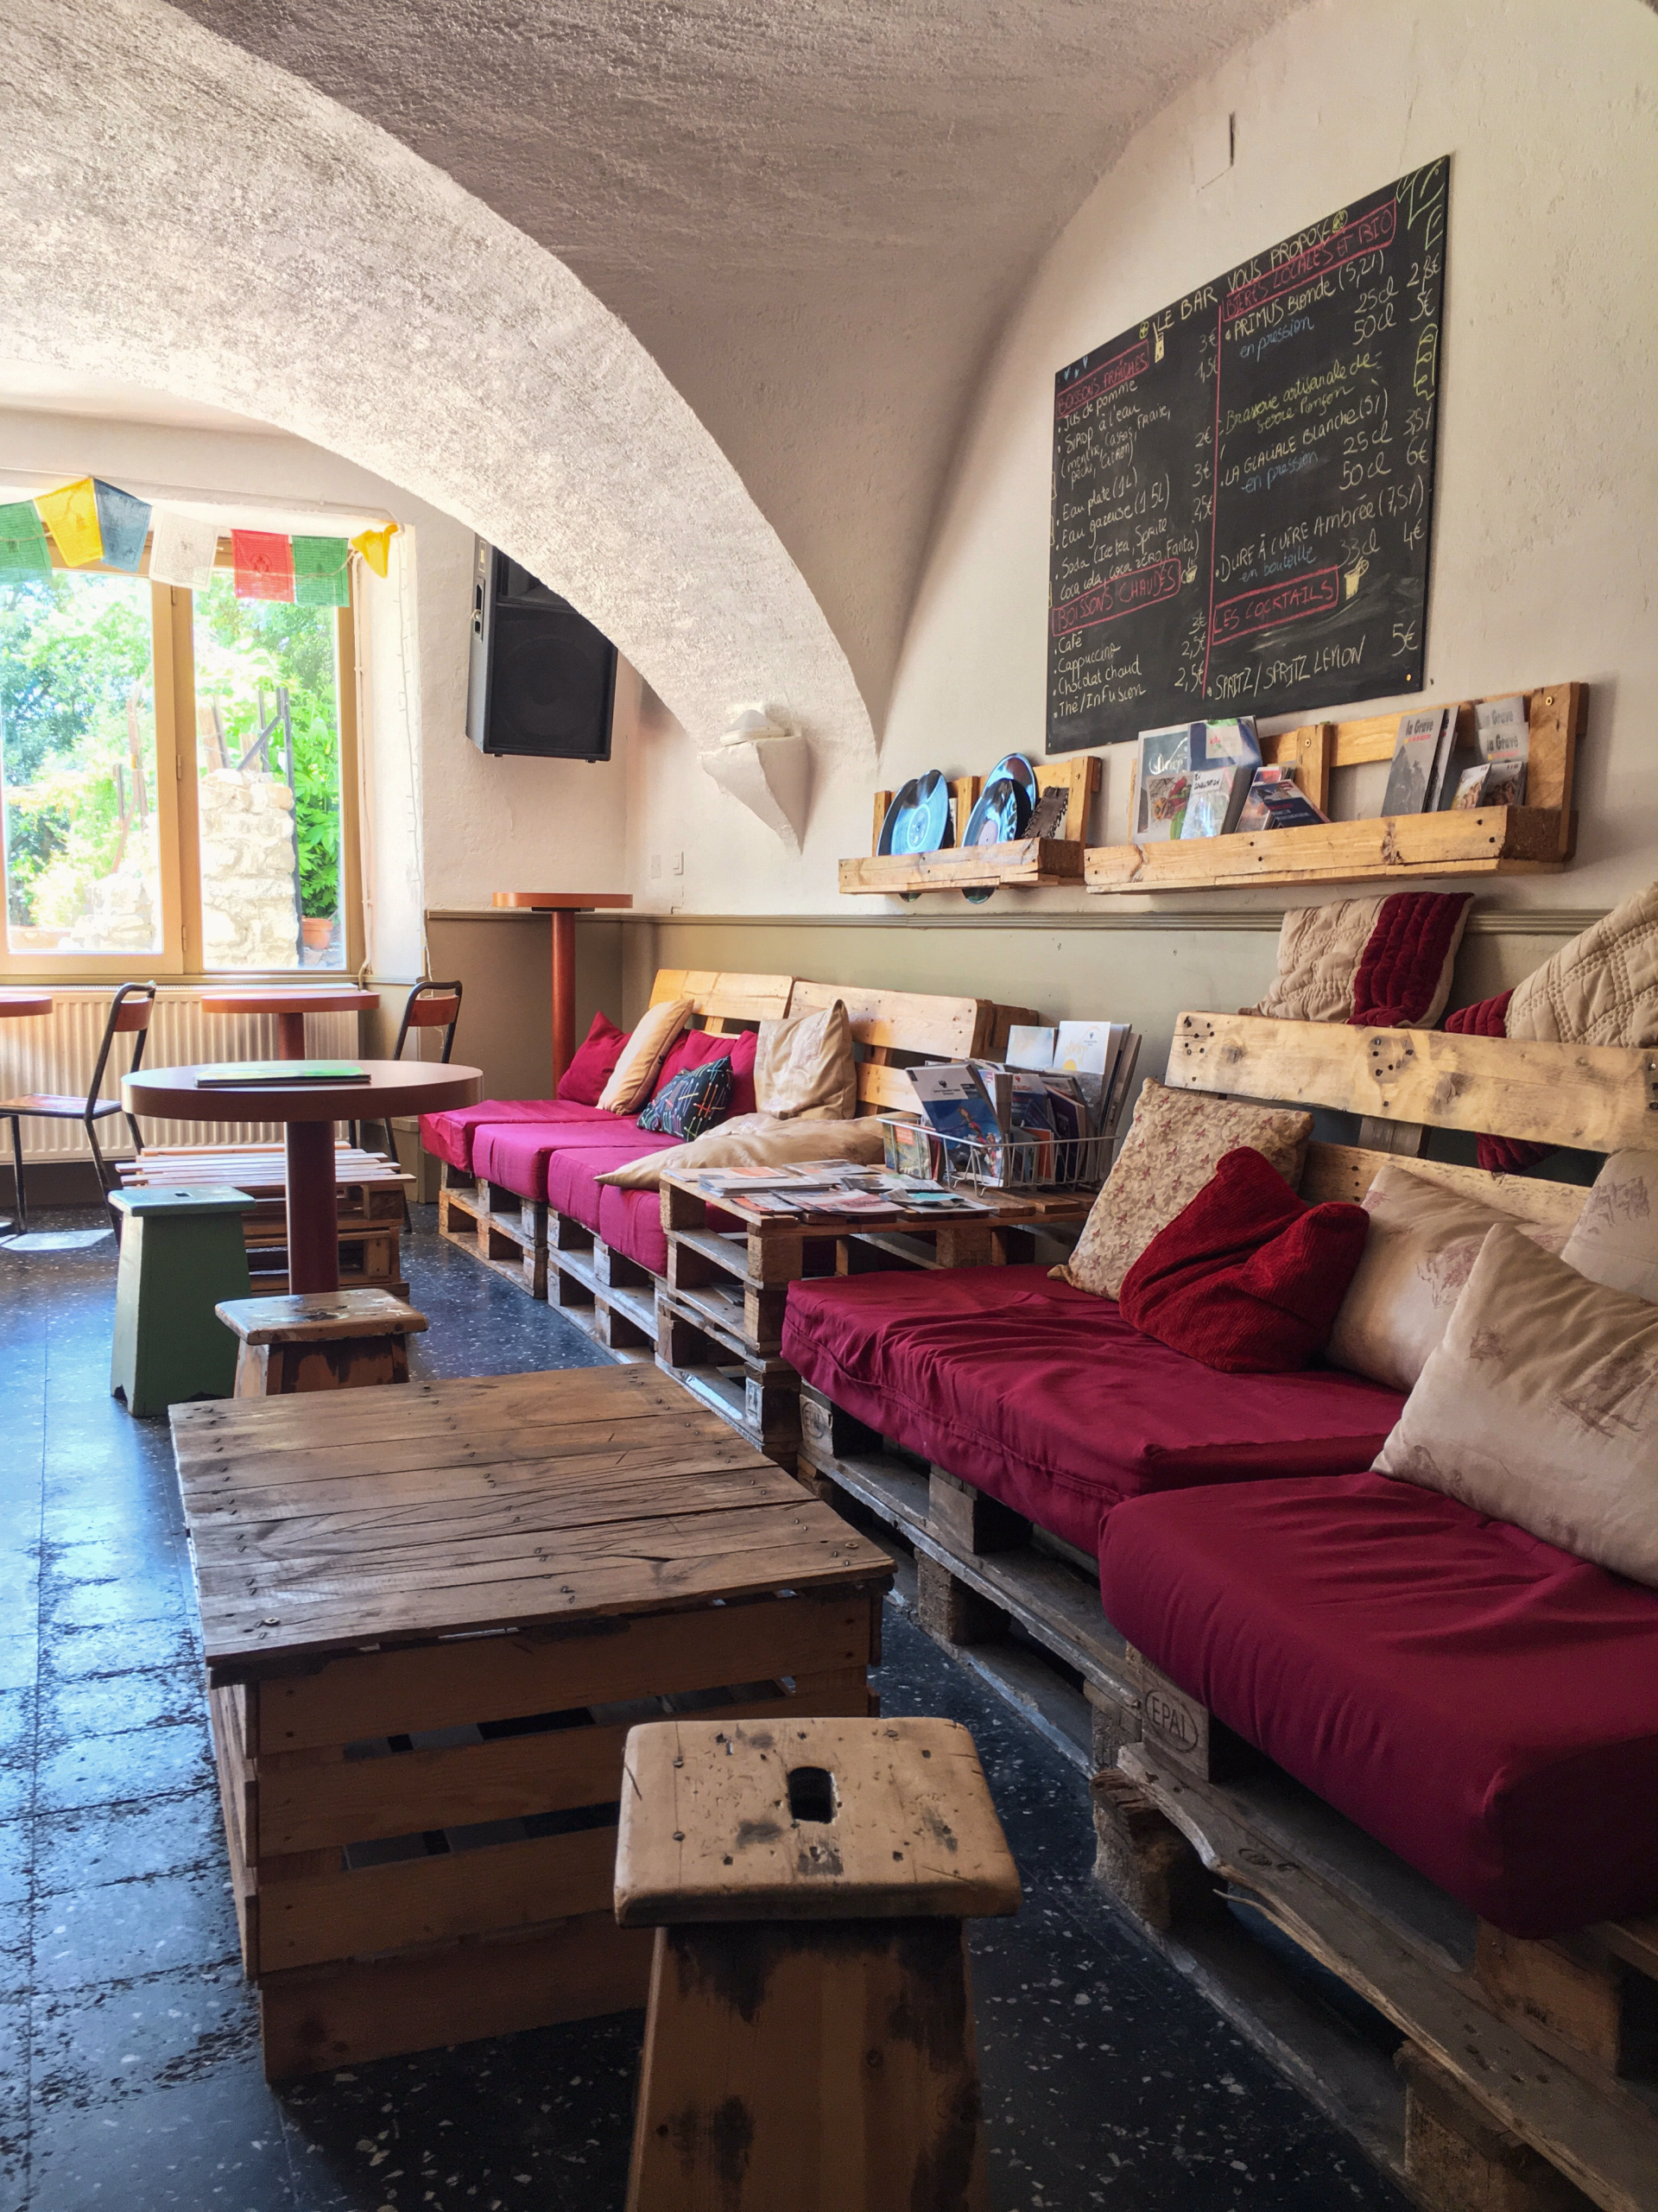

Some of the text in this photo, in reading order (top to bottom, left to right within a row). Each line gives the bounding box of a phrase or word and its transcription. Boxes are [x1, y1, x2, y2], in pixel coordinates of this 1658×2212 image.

[1180, 286, 1218, 320] BAR
[1227, 258, 1262, 295] VOUS
[1270, 218, 1331, 270] PROPOSE
[1274, 245, 1334, 289] LOCALES
[1337, 233, 1355, 258] ET
[1358, 207, 1394, 244] BIO
[1234, 298, 1285, 341] PRIMUS
[1240, 315, 1315, 363] en pression
[1082, 401, 1094, 419] de
[1096, 379, 1138, 417] pomme
[1199, 326, 1218, 353] 3€
[1225, 352, 1378, 435] Brasserie artisanale de
[1058, 377, 1101, 415] BOISSONS
[1195, 426, 1212, 448] 2€
[1406, 435, 1429, 466] 6€
[1062, 503, 1085, 522] Eau
[1087, 486, 1111, 517] plate
[1192, 460, 1212, 488] 3€
[1225, 465, 1240, 487] LA
[1240, 451, 1319, 494] en pression
[1061, 528, 1085, 549] Eau
[1089, 504, 1134, 549] gazeuse
[1403, 517, 1425, 551] 4€
[1061, 555, 1091, 580] Soda
[1220, 543, 1256, 583] DURE
[1239, 543, 1318, 583] en bouteille
[1057, 564, 1177, 631] BOISSONS CHAUDES
[1060, 583, 1080, 601] Coca
[1212, 579, 1335, 635] LES COCKTAILS
[1058, 611, 1208, 654] Café 3€
[1313, 634, 1366, 675] LEMON
[1391, 620, 1419, 657] 5€
[1057, 631, 1206, 683] Cappuccino 2,5€
[1104, 653, 1142, 681] chaud
[1174, 660, 1205, 693] 2,5€
[1414, 719, 1434, 734] Grave
[1496, 733, 1519, 751] Grave
[1152, 1695, 1190, 1744] EPAL
